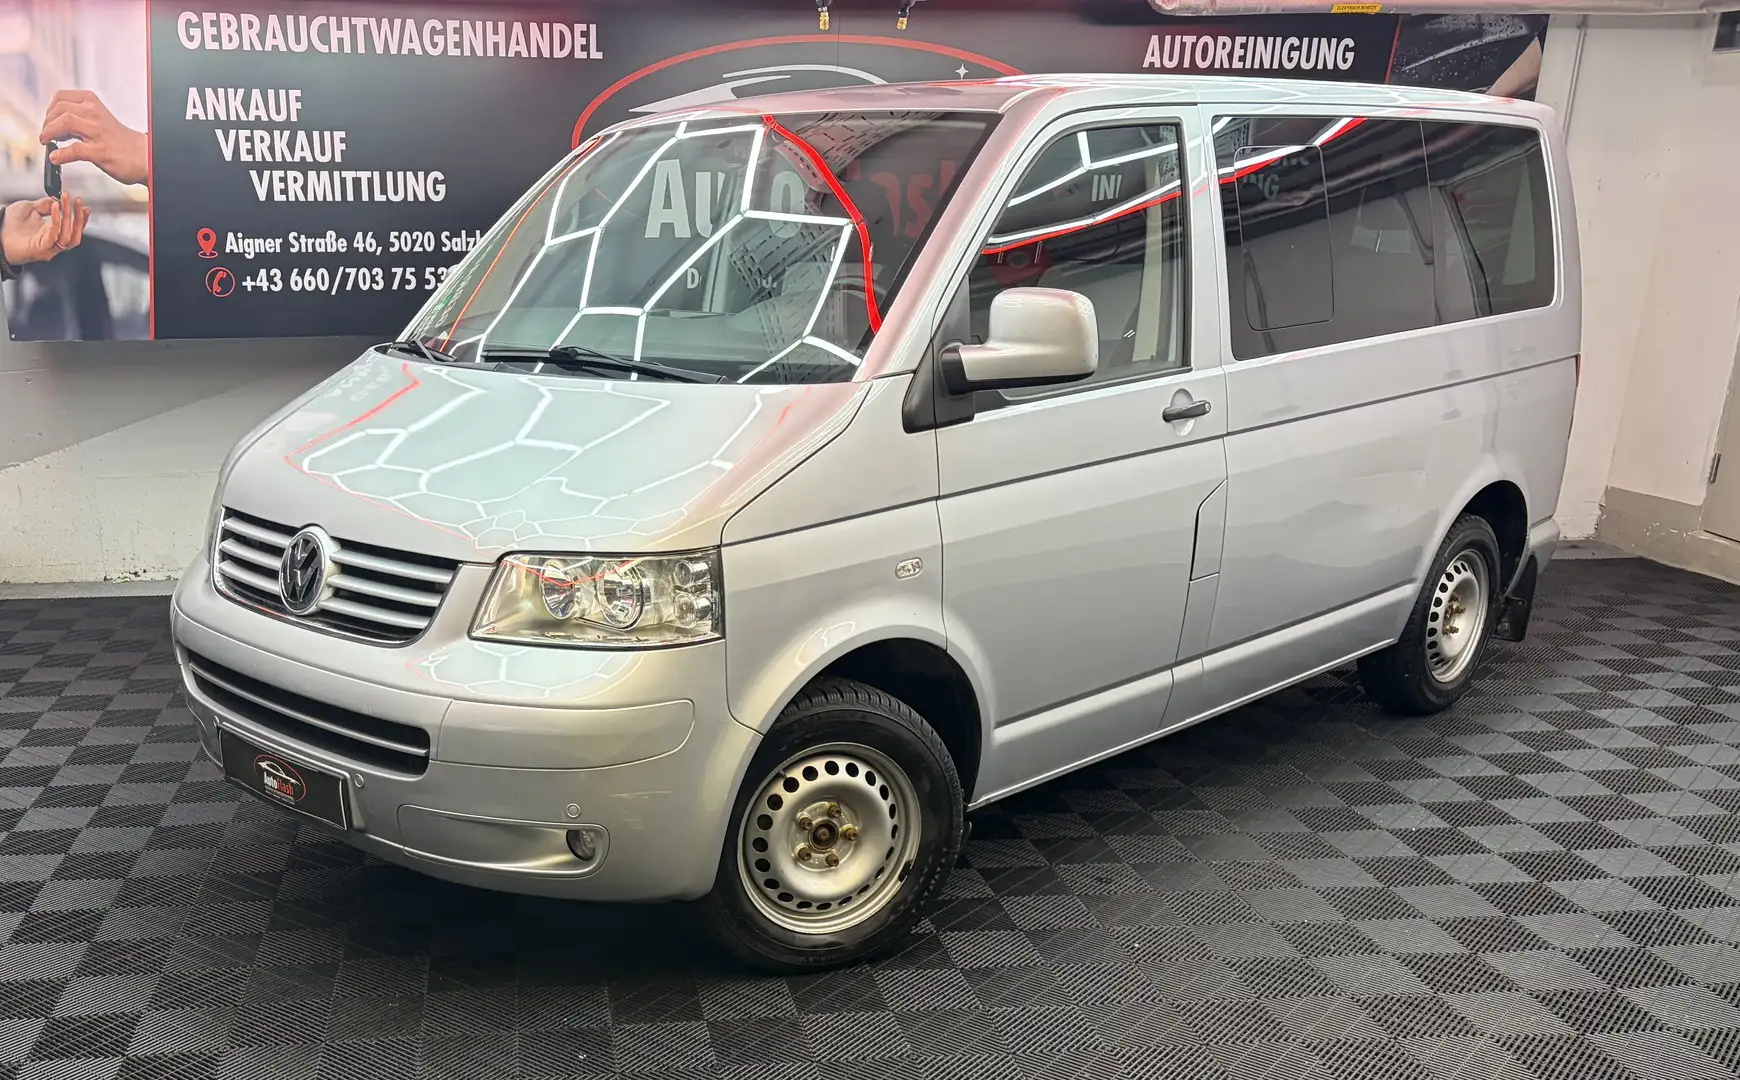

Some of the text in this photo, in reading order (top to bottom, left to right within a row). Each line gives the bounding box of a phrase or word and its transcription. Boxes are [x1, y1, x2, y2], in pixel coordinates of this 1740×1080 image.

[177, 11, 603, 60] GEBRAUCHTWAGENHANDEL
[1142, 34, 1355, 70] AUTOREINIGUNG
[185, 87, 302, 122] ANKAUF
[214, 129, 346, 163] VERKAUF
[249, 170, 447, 202] VERMITTLUNG
[225, 232, 283, 259] Aigner
[288, 230, 347, 253] Straße
[353, 231, 383, 255] 46,
[389, 231, 436, 252] 5020
[242, 268, 283, 292] +43
[290, 266, 385, 296] 660/703
[391, 267, 417, 290] 75
